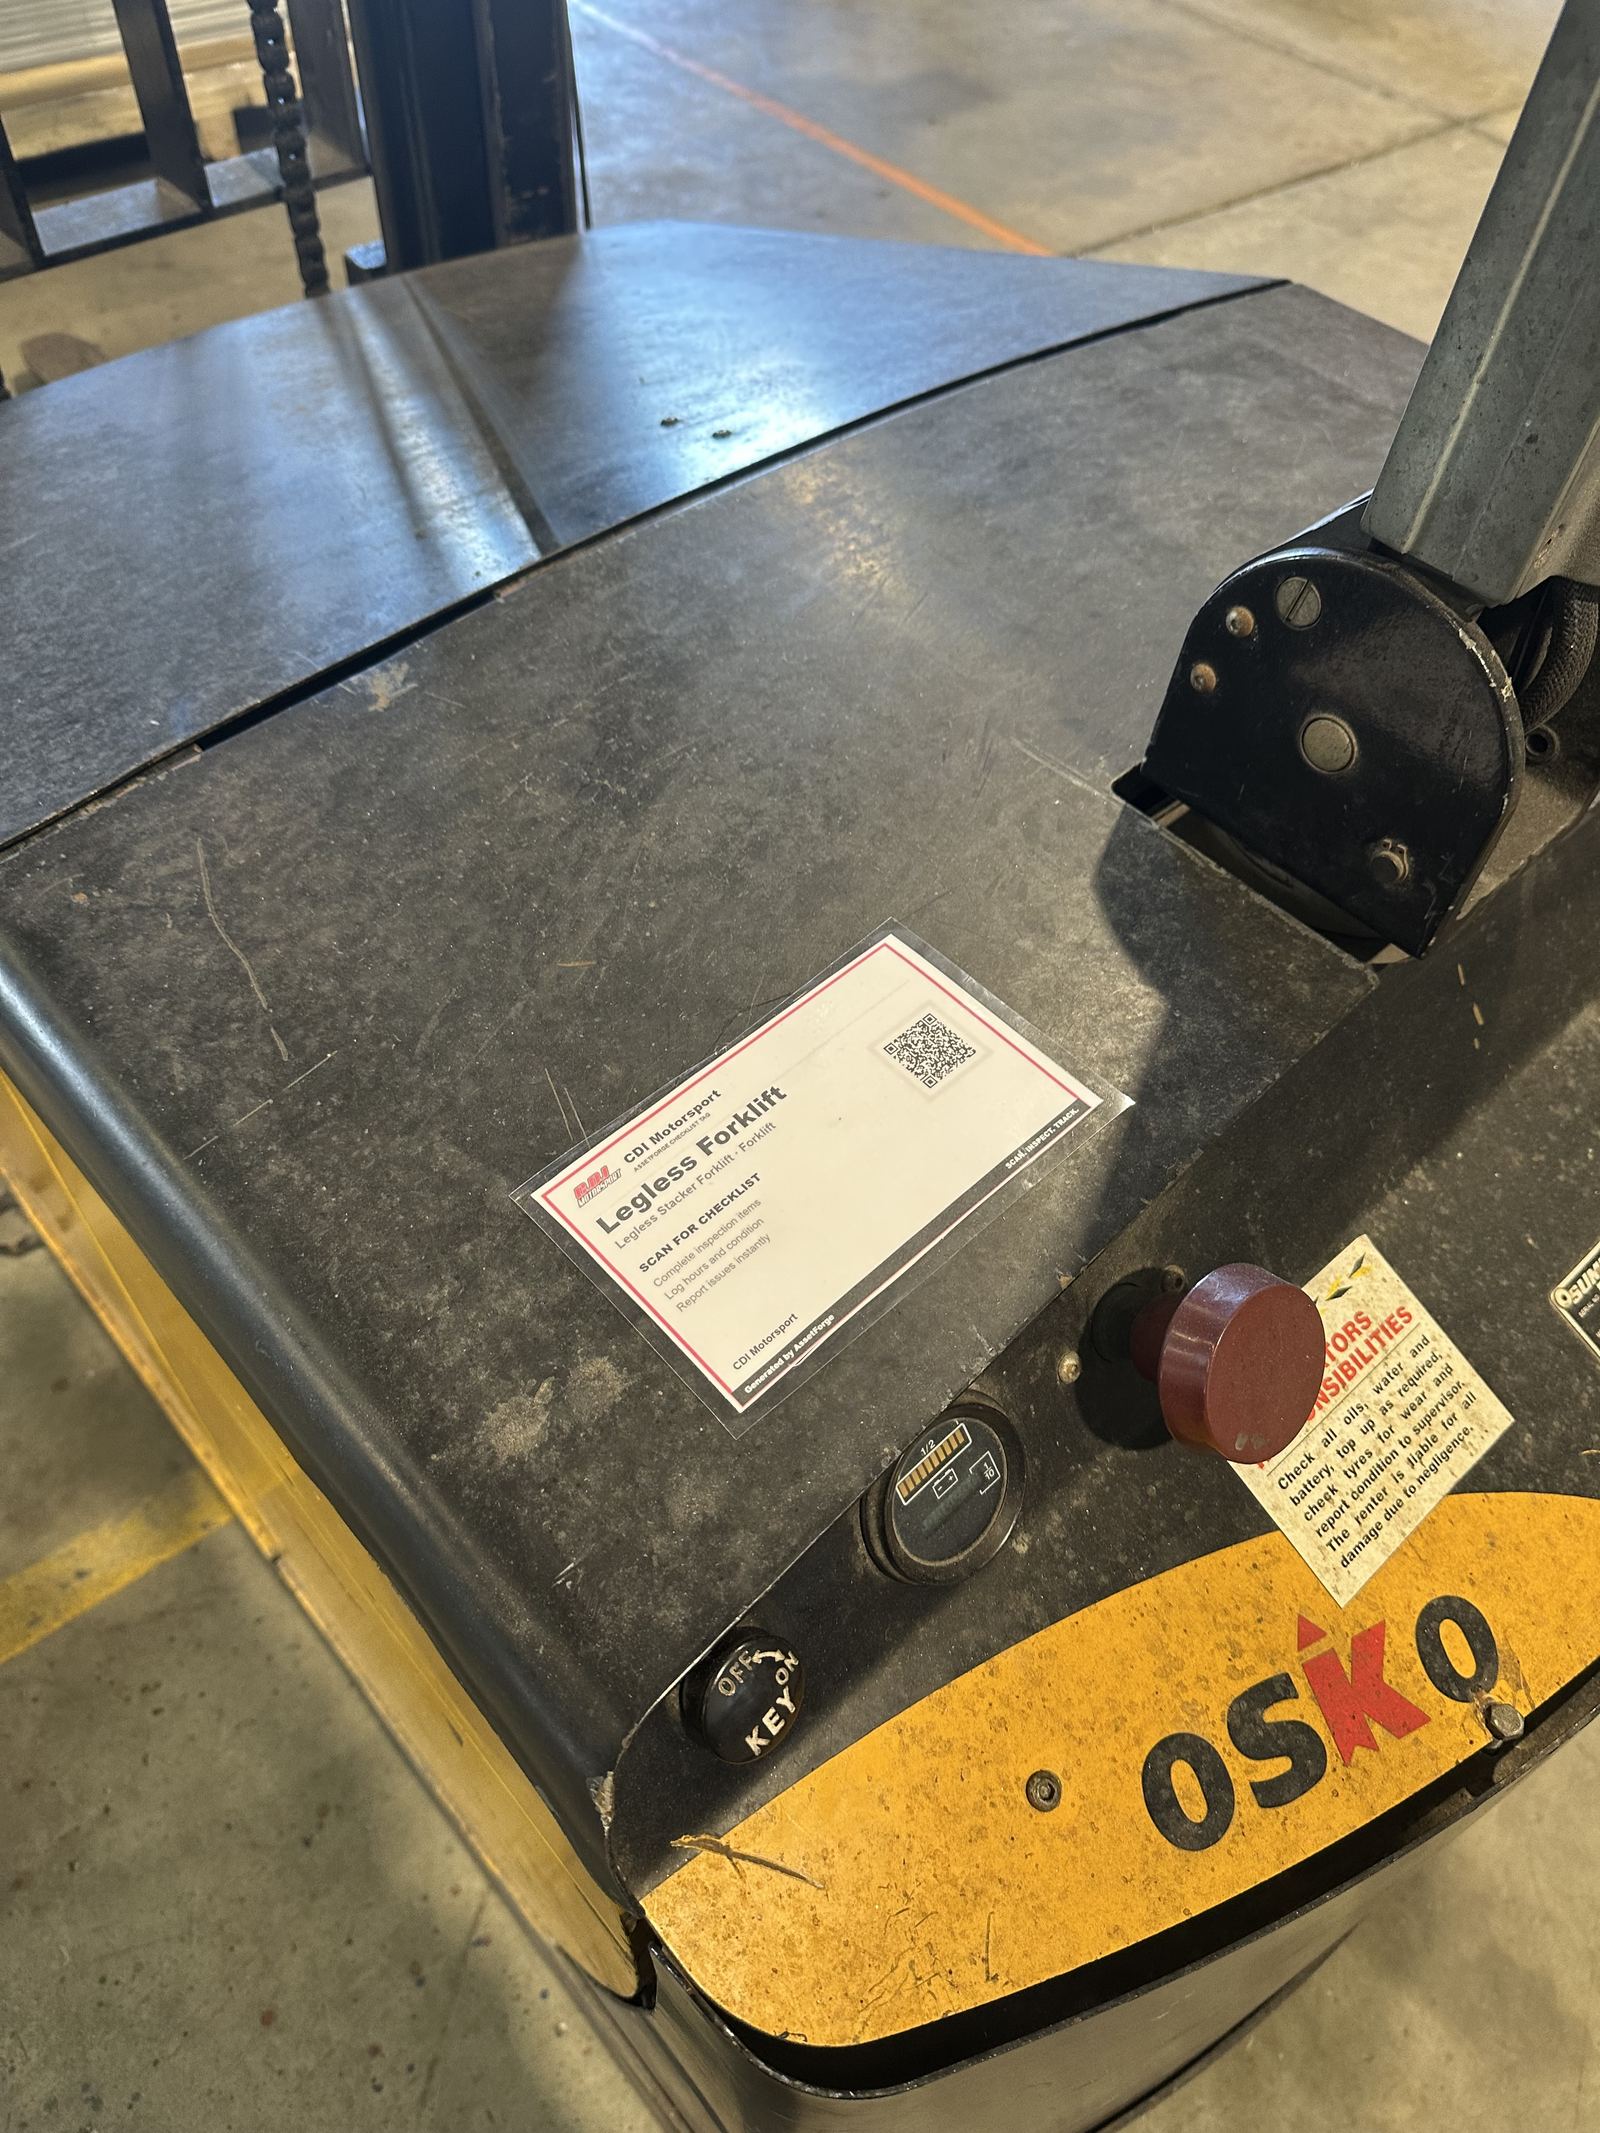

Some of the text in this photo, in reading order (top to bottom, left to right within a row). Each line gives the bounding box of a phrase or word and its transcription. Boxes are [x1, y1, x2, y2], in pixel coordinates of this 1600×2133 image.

[596, 1086, 788, 1234] Legless Forklift
[623, 1090, 722, 1163] CDI Motorsport
[633, 1112, 711, 1172] ASSETFORGE CHECKLIST TAG
[1025, 1126, 1056, 1153] INSPECT.
[1052, 1108, 1080, 1129] TRACK.
[614, 1121, 777, 1249] Legless Stacker Forklift Forklift
[639, 1172, 761, 1273] SCAN FOR CHECKLIST
[653, 1199, 762, 1287] Complete inspection items
[664, 1217, 765, 1300] Log hours and condition
[675, 1233, 771, 1312] Report issues instantly
[1568, 1257, 1600, 1305] SUM
[733, 1313, 799, 1370] CDI Motorsport
[744, 1314, 835, 1394] Generated by AssetForge
[920, 1439, 936, 1455] 1/2
[1277, 1452, 1315, 1490] Check
[1321, 1428, 1338, 1448] all
[1343, 1400, 1370, 1426] oils,
[1372, 1362, 1404, 1395] water
[1409, 1334, 1431, 1358] and
[1289, 1351, 1443, 1507] battery, top up as required,
[1304, 1363, 1454, 1521] check tyres for wear and
[1315, 1380, 1466, 1538] report condition to supervisor.
[1326, 1391, 1477, 1552] The renter is liable for all
[1340, 1425, 1474, 1569] damage due to negligence.
[718, 1650, 753, 1696] OFF
[775, 1651, 799, 1685] ON
[745, 1686, 796, 1756] KEY
[1141, 1595, 1500, 1851] OSKO
